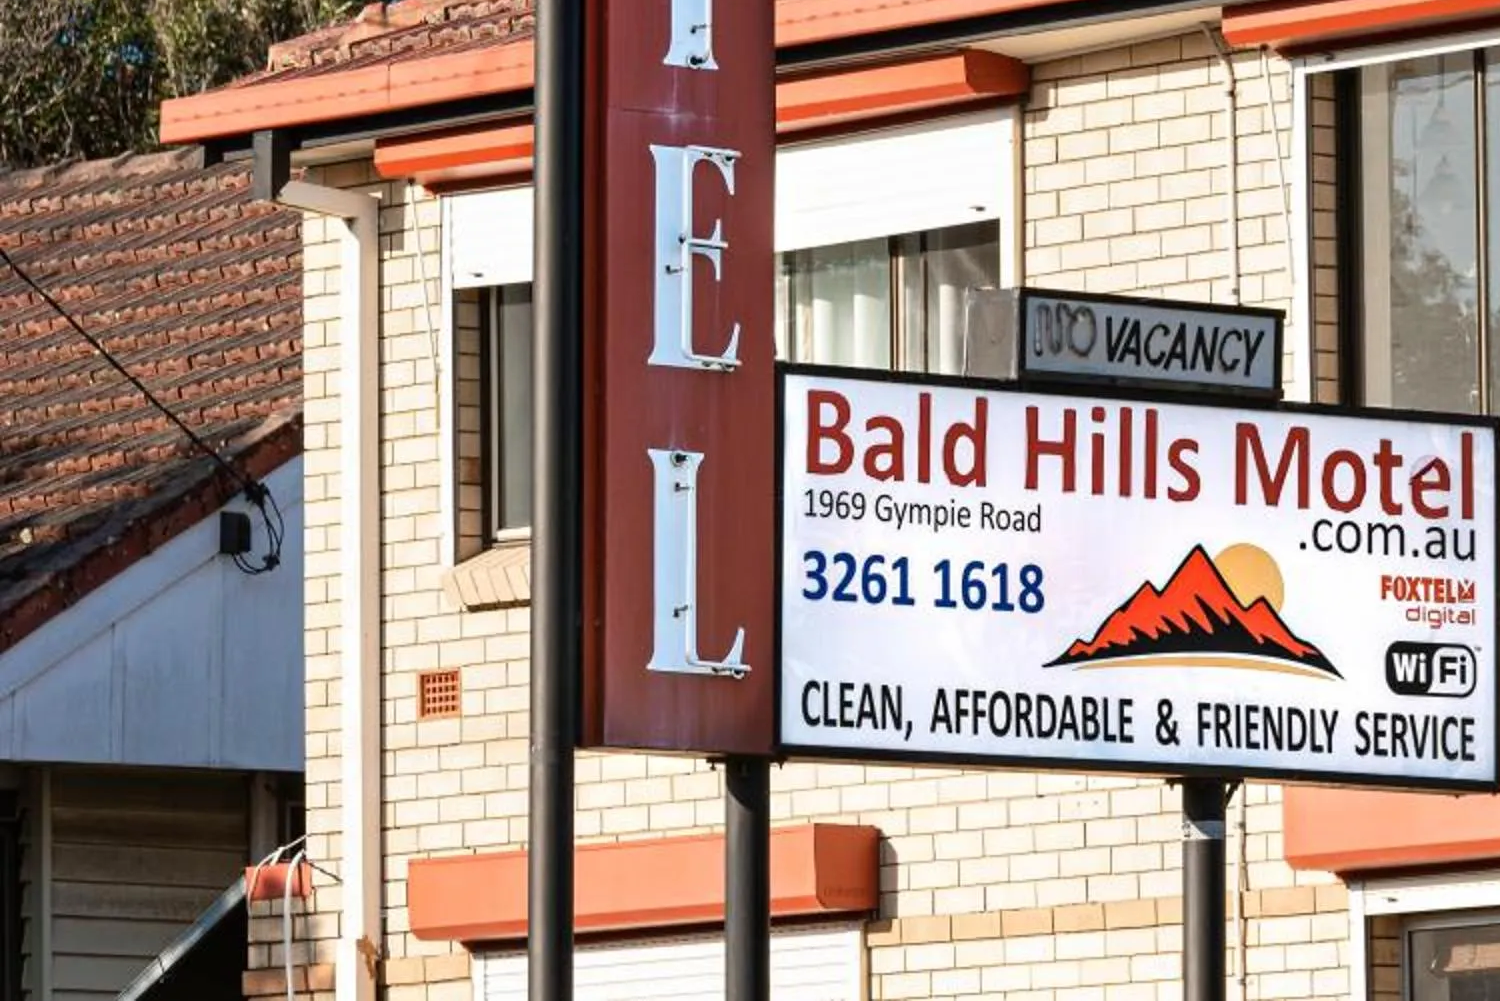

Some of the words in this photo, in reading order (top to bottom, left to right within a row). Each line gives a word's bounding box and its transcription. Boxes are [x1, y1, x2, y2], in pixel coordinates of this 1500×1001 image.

[1105, 315, 1266, 378] VACANCY
[806, 389, 989, 488] Bald
[1024, 405, 1201, 503] Hills
[1235, 422, 1475, 521] Motel
[804, 489, 866, 520] 1969
[875, 493, 973, 532] Gympie
[981, 501, 1041, 533] Road
[1299, 516, 1476, 562] .com.au
[802, 550, 916, 606] 3261
[932, 559, 1045, 614] 1618
[1381, 575, 1456, 603] FOXTEL
[1405, 605, 1476, 629] digital
[801, 680, 913, 741] CLEAN,
[930, 688, 1134, 744] AFFORDABLE
[1155, 698, 1180, 746] &
[1197, 702, 1339, 754] FRIENDLY
[1355, 710, 1475, 762] SERVICE
